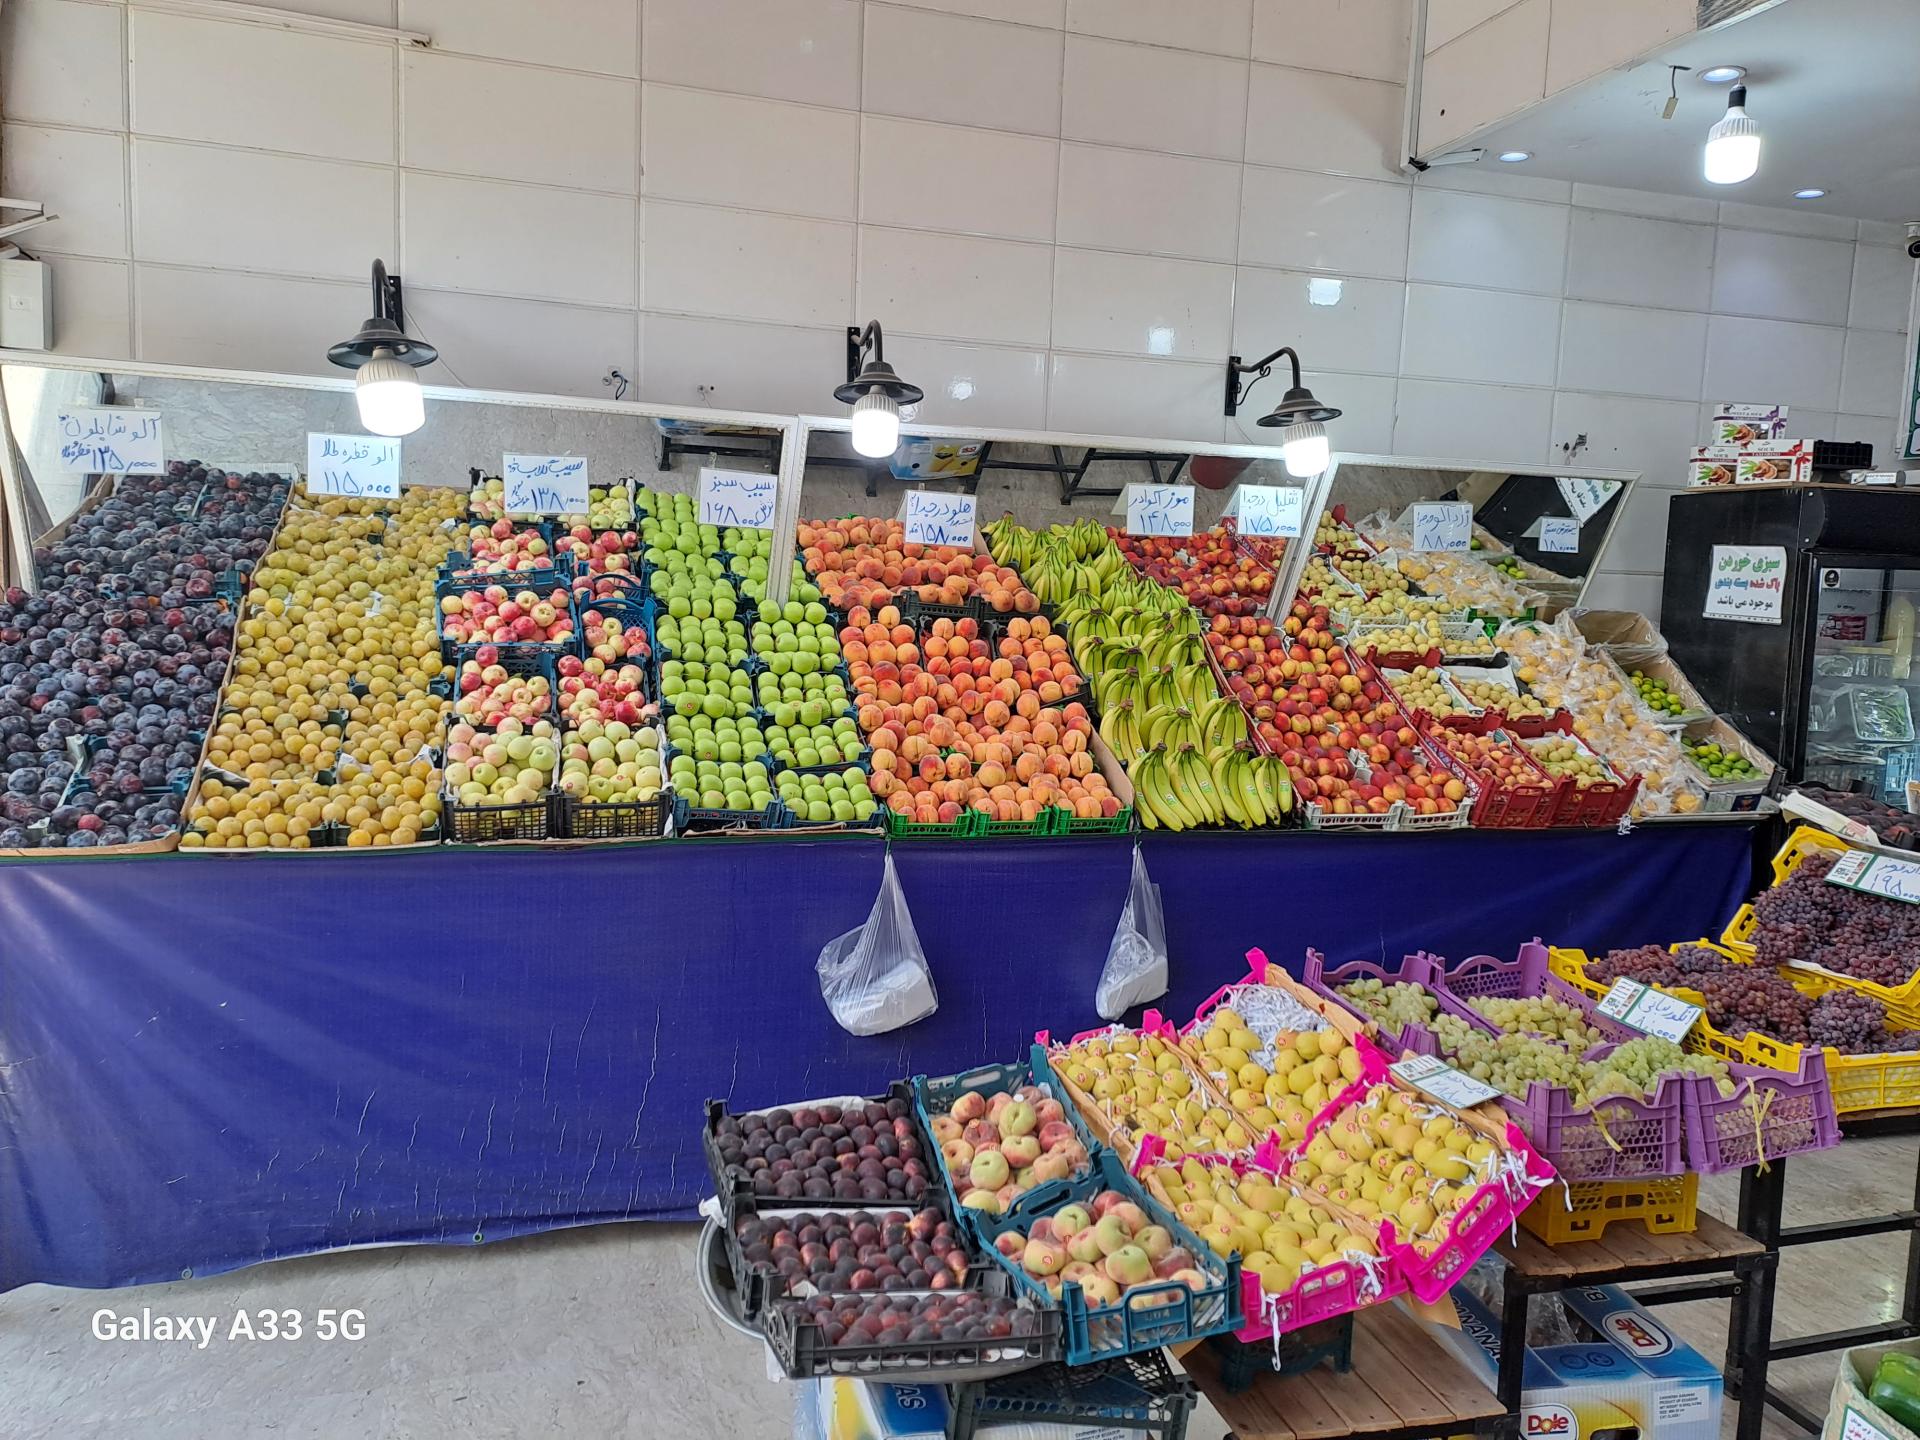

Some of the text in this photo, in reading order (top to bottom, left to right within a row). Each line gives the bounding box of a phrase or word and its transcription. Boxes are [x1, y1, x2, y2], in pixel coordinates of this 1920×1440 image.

[320, 438, 339, 457] طلا
[341, 441, 370, 464] قطره
[549, 460, 584, 477] سیب
[710, 475, 774, 498] سیب سبز
[1163, 492, 1189, 509] موز
[1266, 488, 1299, 517] شلیل
[945, 497, 972, 528] هلو
[1719, 553, 1780, 573] سبزی خوردن
[1714, 577, 1781, 593] پاک شده بسته بندی
[1717, 595, 1774, 610] موجود می باشد
[1614, 1317, 1657, 1347] Dole
[1527, 1413, 1569, 1434] Dole
